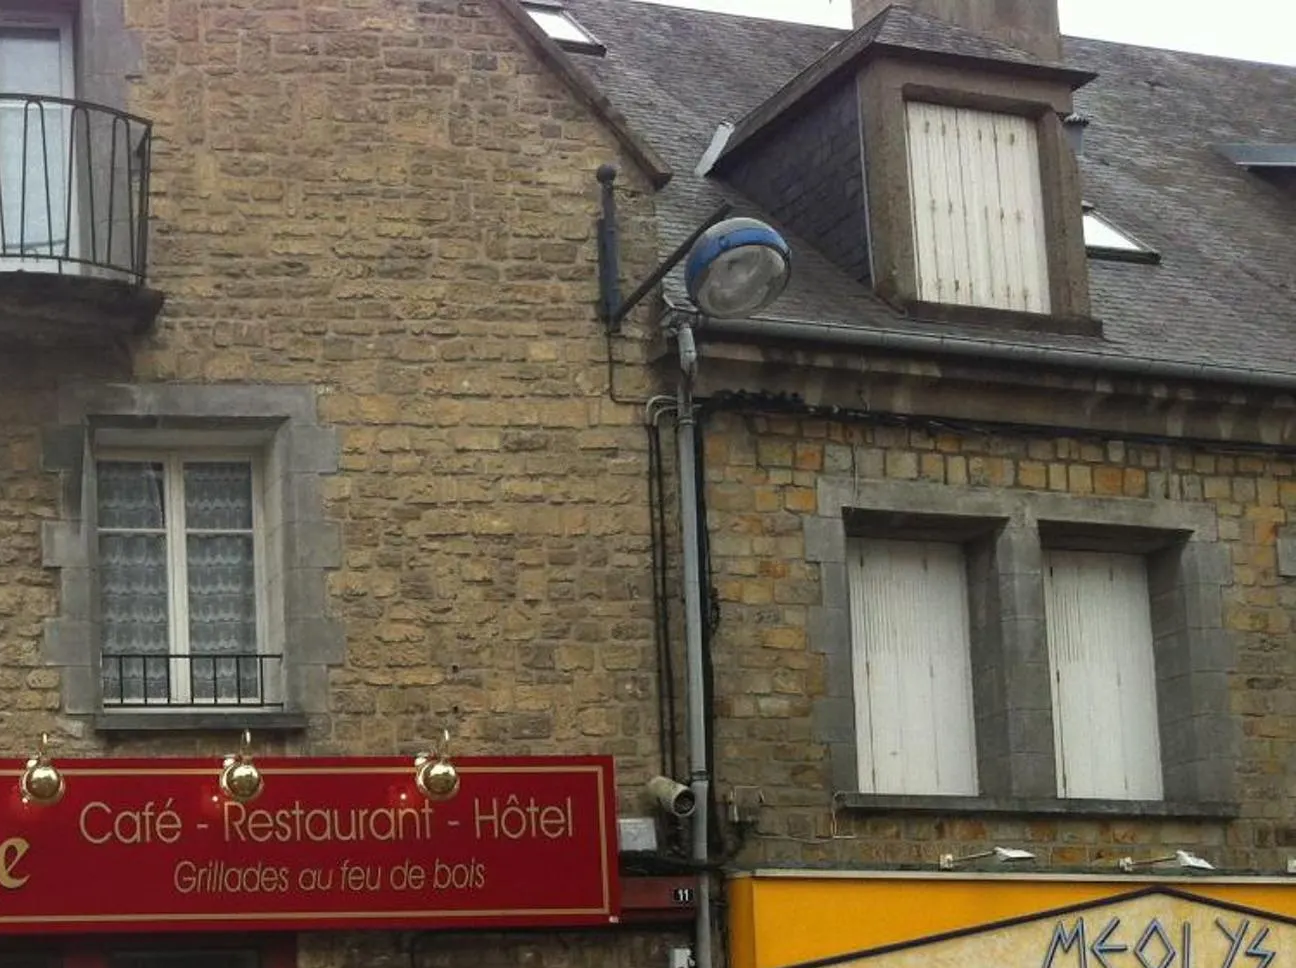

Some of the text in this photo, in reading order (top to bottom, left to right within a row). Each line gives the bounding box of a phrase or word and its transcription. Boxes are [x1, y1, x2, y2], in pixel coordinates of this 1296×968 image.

[78, 796, 182, 845] Café
[222, 798, 434, 843] Restaurant
[473, 795, 574, 841] Hôtel
[173, 856, 486, 894] Grillades au feu de bois
